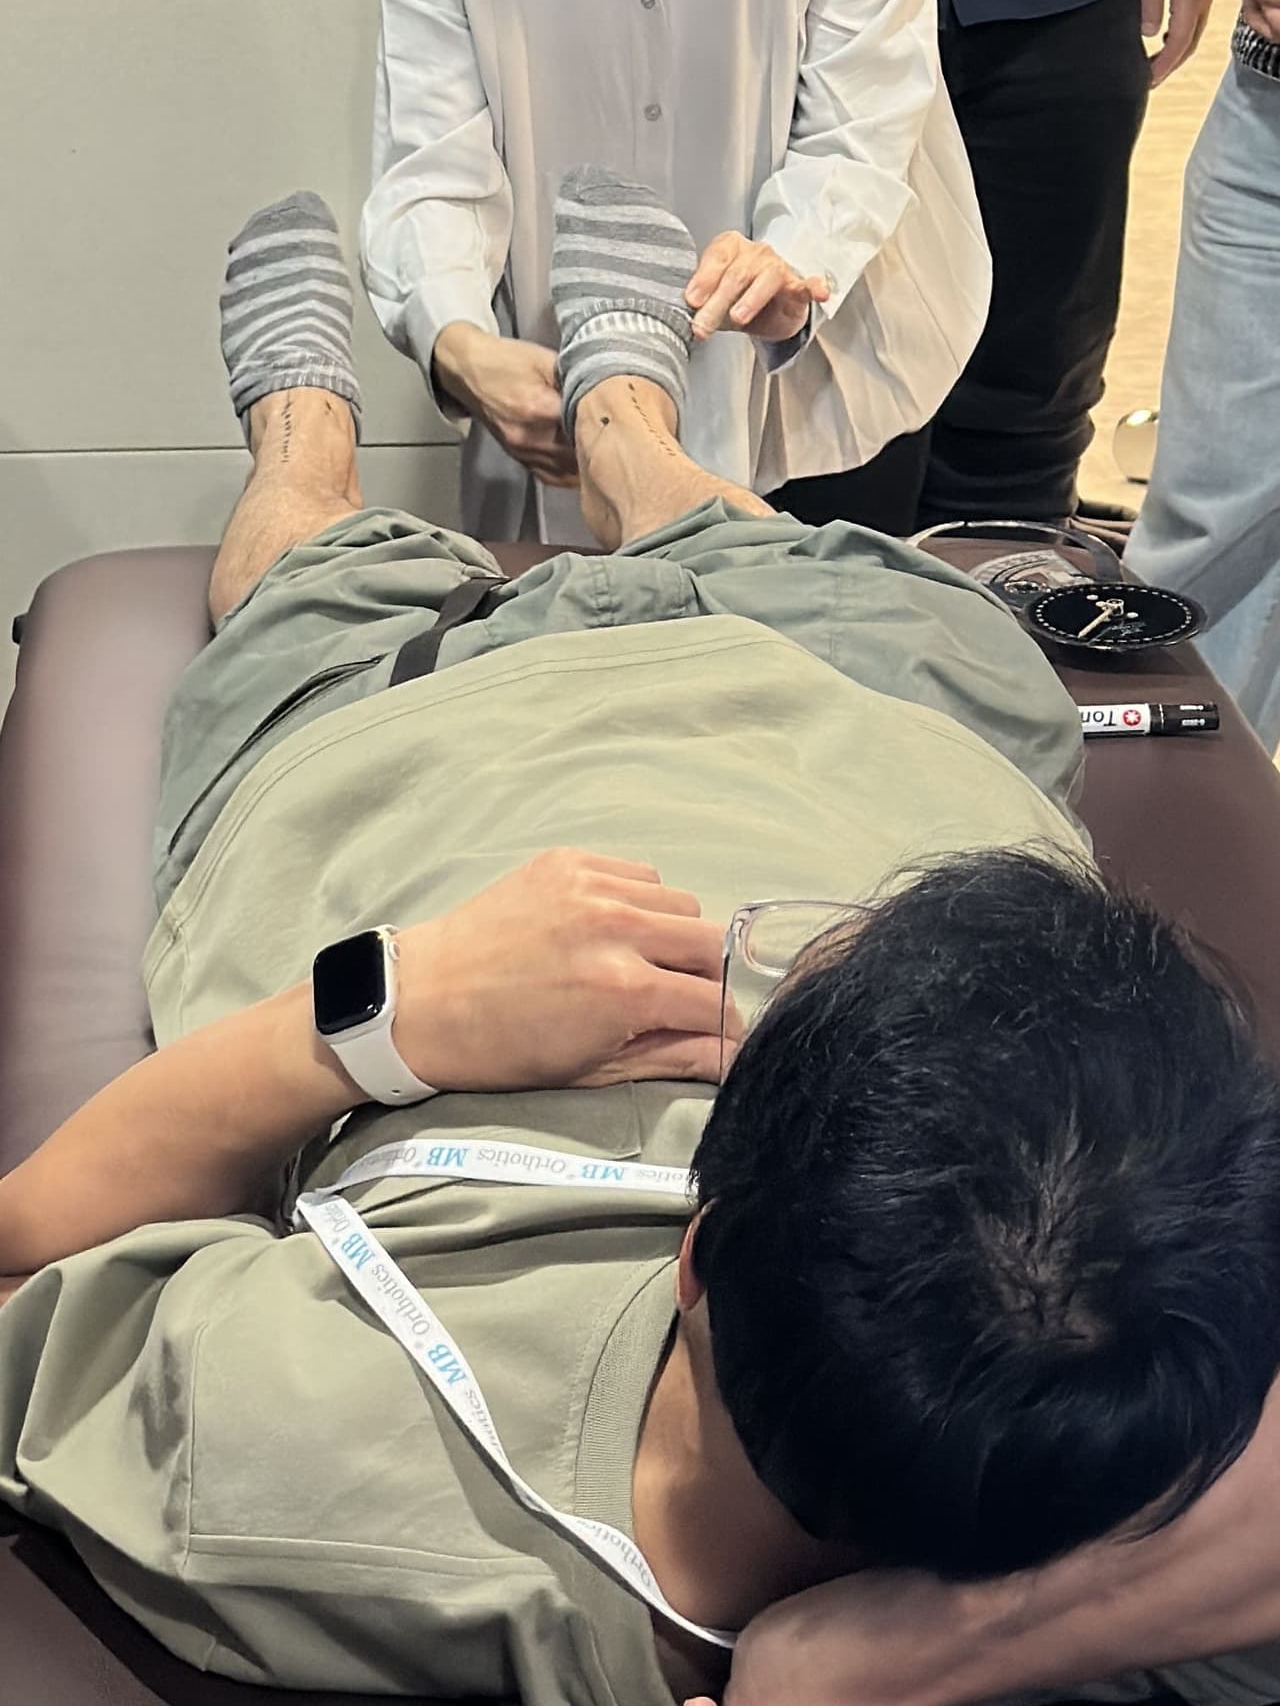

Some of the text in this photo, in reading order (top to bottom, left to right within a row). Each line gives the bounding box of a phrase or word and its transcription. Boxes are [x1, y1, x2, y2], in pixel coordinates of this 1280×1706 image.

[426, 1146, 471, 1168] MB
[477, 1148, 625, 1182] MB Orthotics
[341, 1233, 377, 1271] MB
[370, 1263, 469, 1386] MB Orthotics
